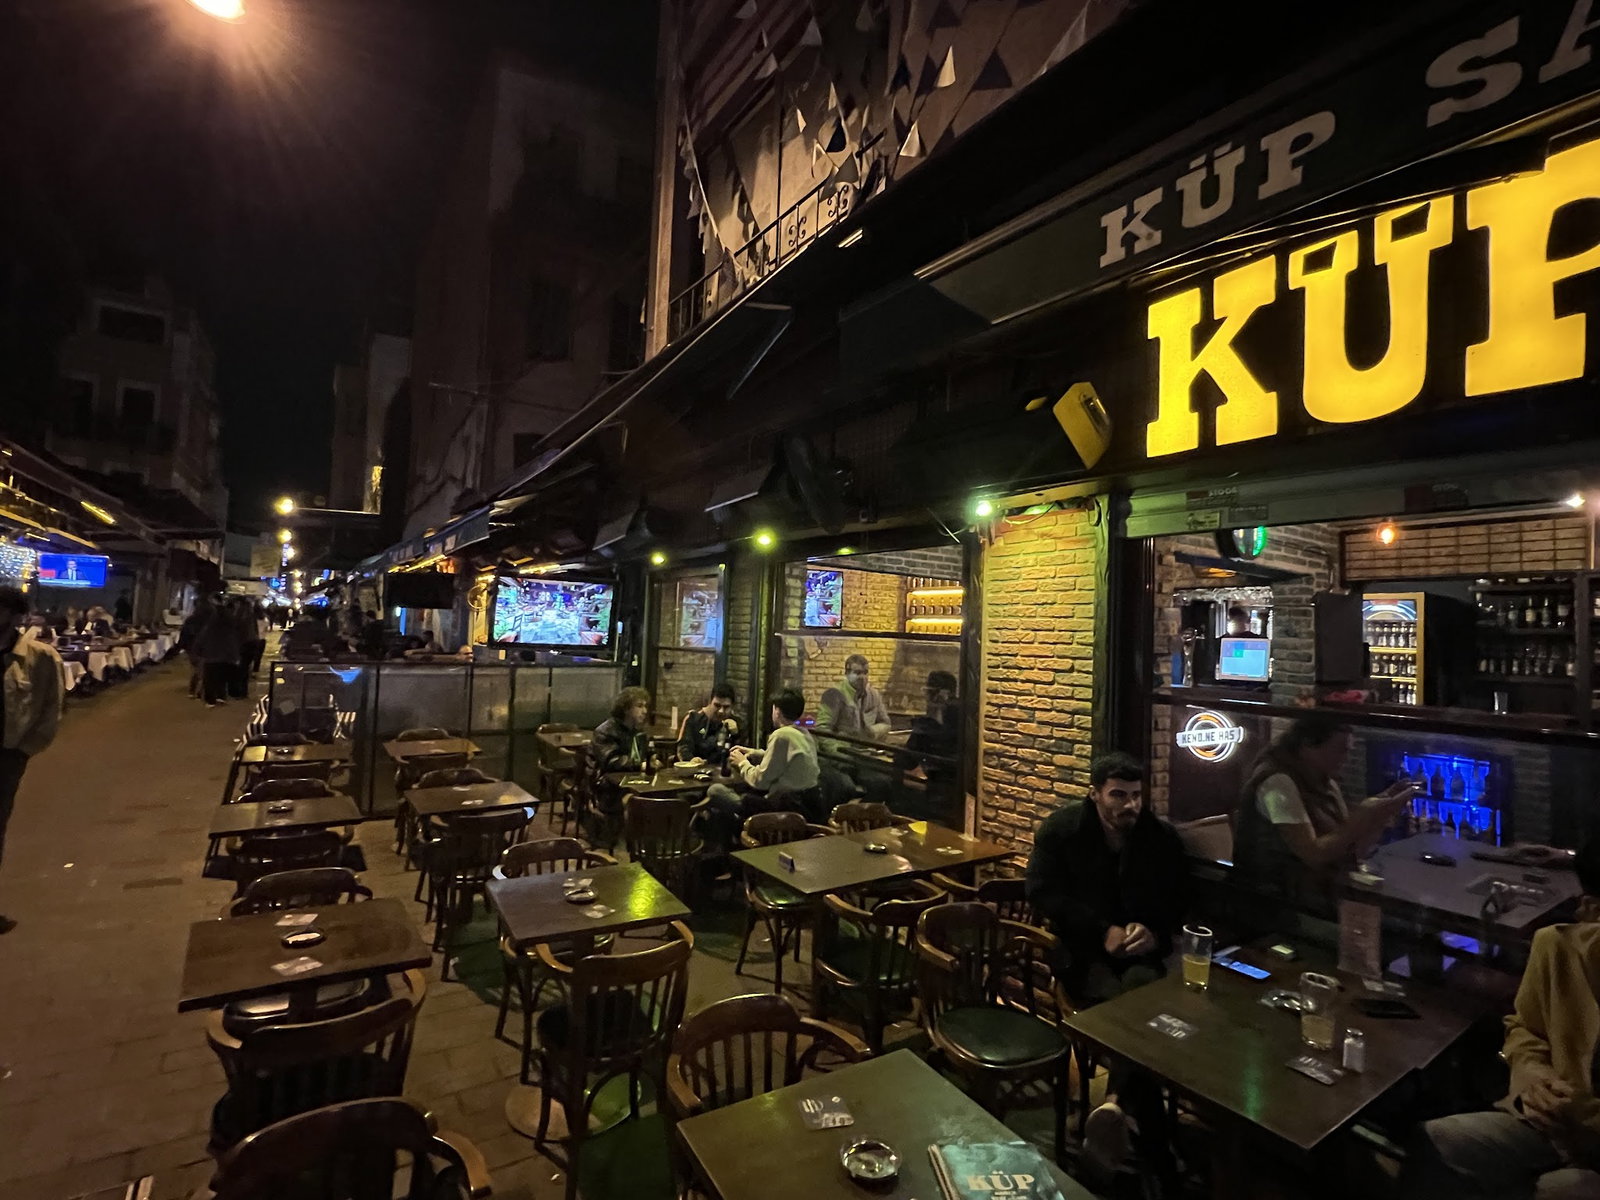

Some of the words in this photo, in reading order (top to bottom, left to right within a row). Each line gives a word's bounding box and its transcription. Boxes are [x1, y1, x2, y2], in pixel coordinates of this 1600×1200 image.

[1100, 111, 1336, 268] KÜP
[1146, 138, 1600, 458] KÜP
[967, 1170, 1035, 1190] KÜP
